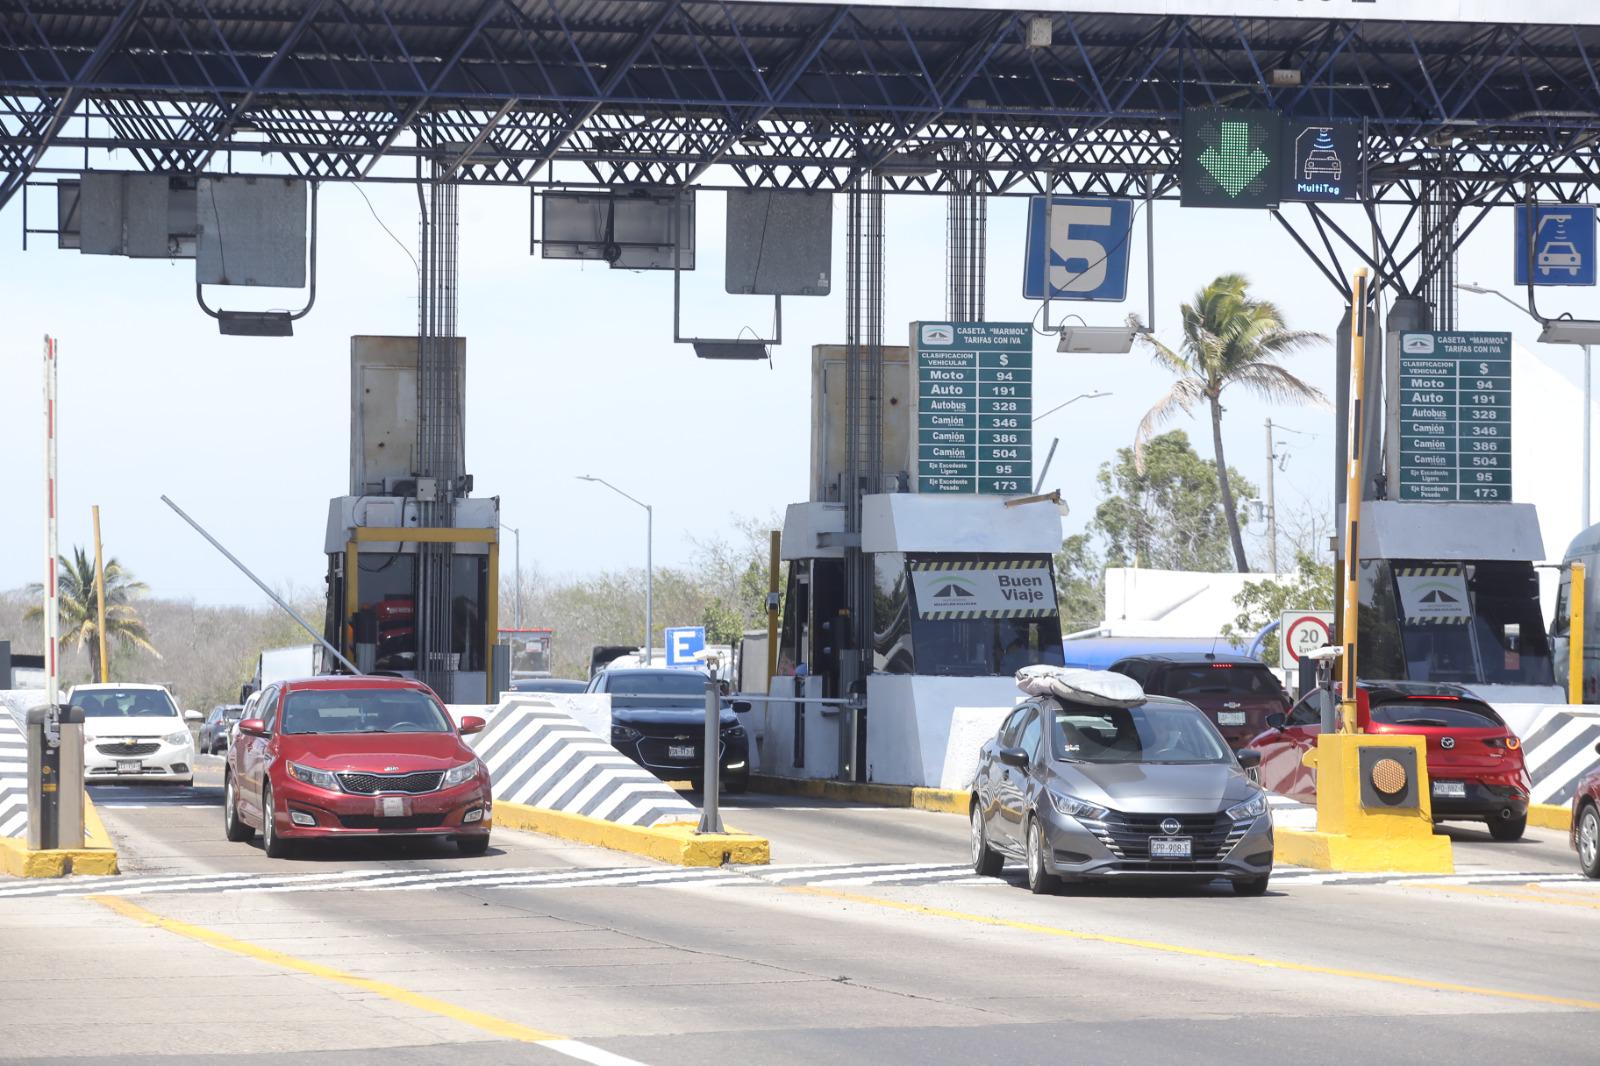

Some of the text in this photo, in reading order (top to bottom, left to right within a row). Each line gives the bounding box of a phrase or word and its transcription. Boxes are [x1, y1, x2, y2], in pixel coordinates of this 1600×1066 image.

[1298, 184, 1340, 195] MultiTag
[1049, 204, 1112, 292] 5
[1000, 354, 1008, 366] $
[1480, 363, 1488, 375] $
[930, 371, 1012, 380] Moto 94
[931, 385, 962, 394] Auto
[1412, 379, 1492, 389] Moto 94
[1412, 393, 1443, 402] Auto
[931, 400, 1016, 410] Autobus 328
[1412, 408, 1496, 419] Autobus 328
[932, 416, 1017, 427] Camión 346
[1413, 424, 1497, 435] Camión 346
[933, 432, 1017, 443] Camión 386
[1414, 440, 1497, 450] Camión 386
[993, 450, 1017, 458] 504
[1415, 455, 1497, 466] Camión 504
[996, 465, 1012, 474] 95
[1476, 473, 1492, 481] 95
[993, 481, 1017, 490] 173
[1474, 489, 1497, 497] 173
[998, 576, 1042, 587] Buen
[1002, 589, 1044, 603] Viaje
[1300, 629, 1318, 643] 20
[673, 631, 698, 662] E
